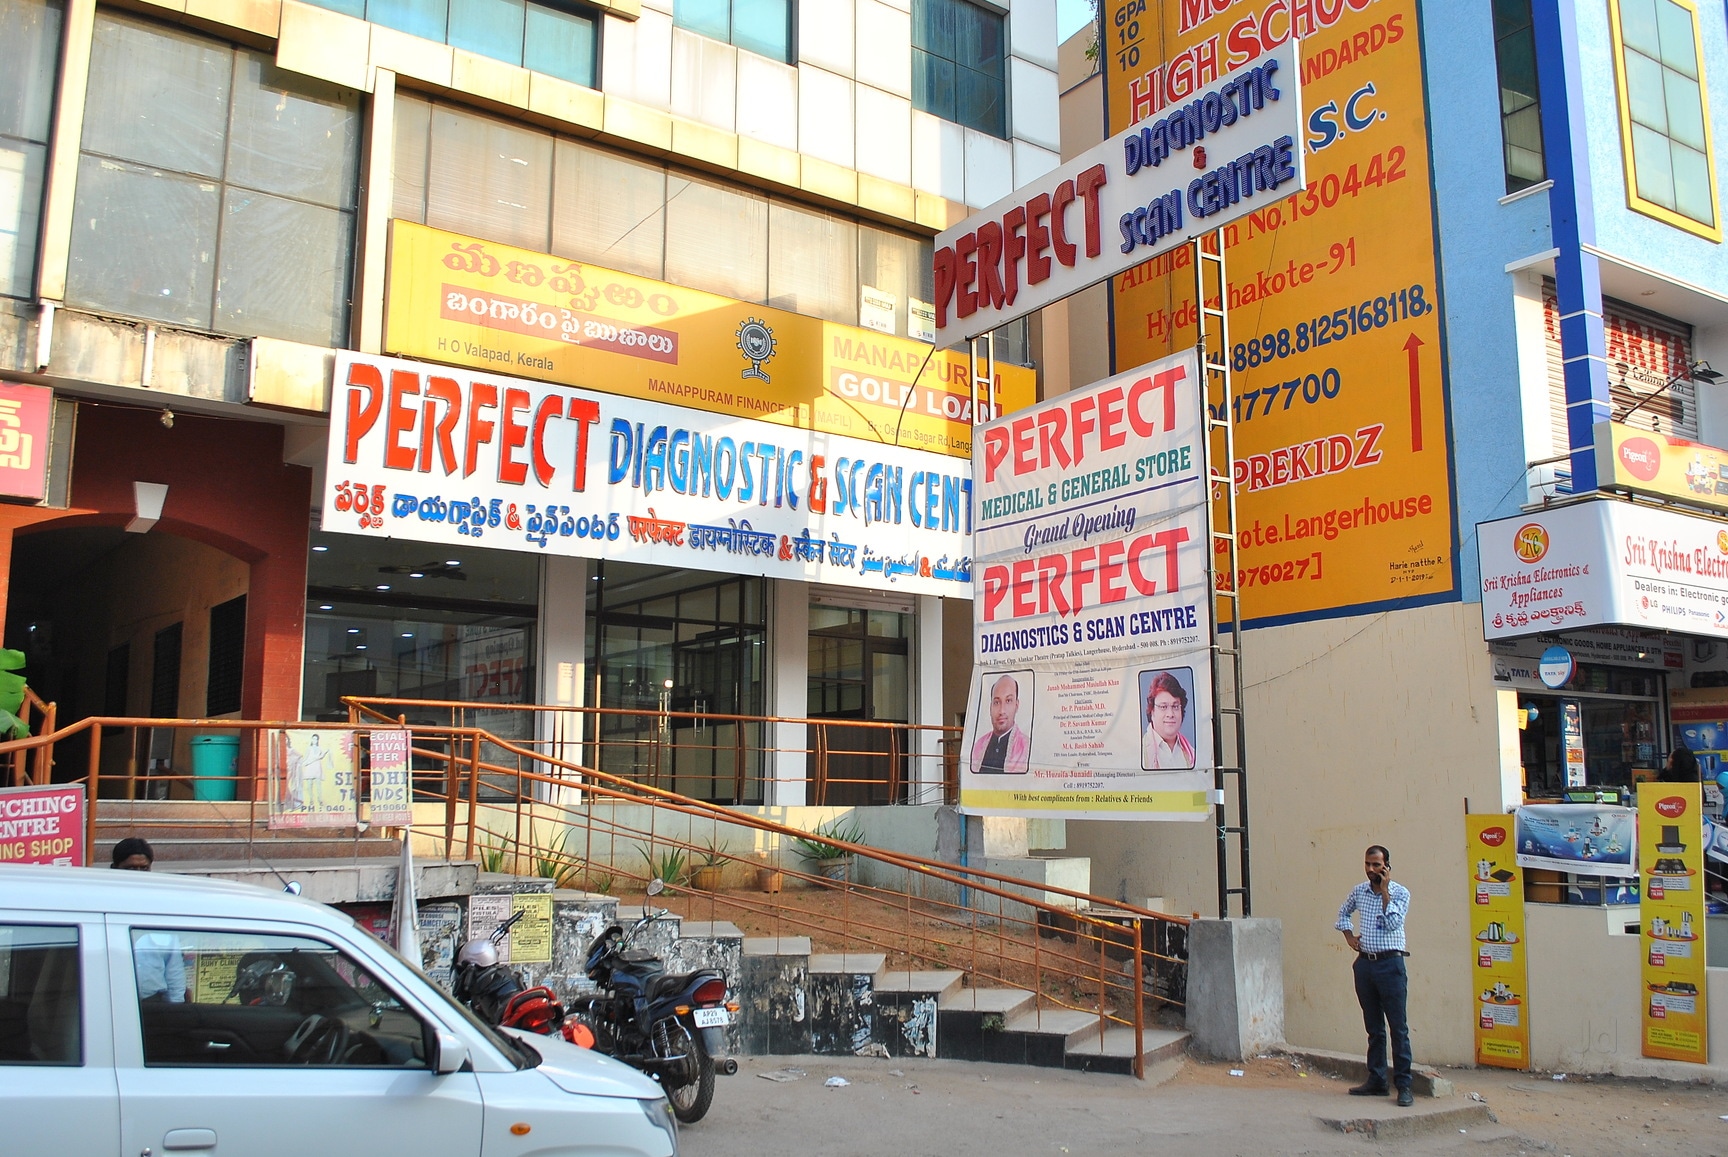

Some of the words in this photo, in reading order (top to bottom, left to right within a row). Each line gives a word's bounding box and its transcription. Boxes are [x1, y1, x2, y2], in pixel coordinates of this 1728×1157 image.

[1115, 1, 1146, 27] GPA
[1118, 20, 1140, 45] 10
[1119, 50, 1140, 72] 10
[1299, 14, 1404, 86] ANDARDS
[1128, 33, 1219, 127] HIGH
[1124, 58, 1280, 177] DIAGNOSTIC
[1192, 145, 1206, 170] &
[1119, 188, 1182, 254] SCAN
[1187, 135, 1295, 219] CENTRE
[934, 163, 1107, 329] PERFECT
[438, 337, 446, 351] H
[450, 339, 460, 353] O
[463, 341, 514, 366] Valapad,
[517, 347, 554, 371] Kerala
[648, 377, 734, 407] MANAPPURAM
[736, 394, 785, 416] FINANCE
[837, 372, 918, 410] GOLD
[925, 391, 1001, 427] LOAN
[984, 365, 1186, 483] PERFECT
[343, 363, 600, 492] PERFECT
[608, 417, 802, 511] DIAGNOSTIC
[808, 455, 827, 514] &
[833, 456, 903, 527] SCAN
[909, 470, 973, 536] CENT
[913, 428, 936, 446] Sagar
[951, 435, 973, 453] Langa
[1234, 425, 1383, 494] PREKIDZ
[1623, 446, 1647, 463] Pigeon
[982, 487, 1043, 520] MEDICAL
[1048, 483, 1056, 505] &
[1061, 464, 1130, 503] GENERAL
[1135, 445, 1191, 482] STORE
[505, 503, 522, 529] &
[1024, 517, 1070, 554] Grand
[1072, 505, 1136, 541] Opening
[779, 534, 793, 561] &
[1625, 535, 1646, 566] Srii
[1649, 539, 1691, 574] Krishna
[1694, 545, 1728, 579] Electro
[920, 556, 931, 577] &
[983, 527, 1190, 621] PERFECT
[1483, 578, 1498, 593] Srii
[1499, 570, 1532, 591] Krishna
[1533, 563, 1580, 584] Electronics
[1509, 586, 1563, 609] Appliances
[1635, 580, 1666, 595] Dealers
[1668, 585, 1678, 596] in:
[1680, 587, 1719, 603] Electronic
[1650, 600, 1658, 608] LG
[1662, 604, 1686, 616] PHILIPS
[981, 622, 1069, 653] DIAGNOSTICS
[1073, 621, 1082, 642] &
[1087, 616, 1125, 641] SCAN
[1130, 605, 1197, 635] CENTRE
[1511, 668, 1530, 680] TATA
[335, 771, 407, 786] SIDHI
[0, 795, 77, 818] TCHING
[339, 787, 403, 802] TRNDS
[1028, 793, 1040, 802] best
[1095, 794, 1122, 803] Relatives
[1130, 795, 1153, 804] Friends
[1658, 801, 1677, 812] Pigeon
[0, 816, 60, 839] NTRE
[0, 842, 25, 860] ING
[31, 837, 74, 857] SHOP
